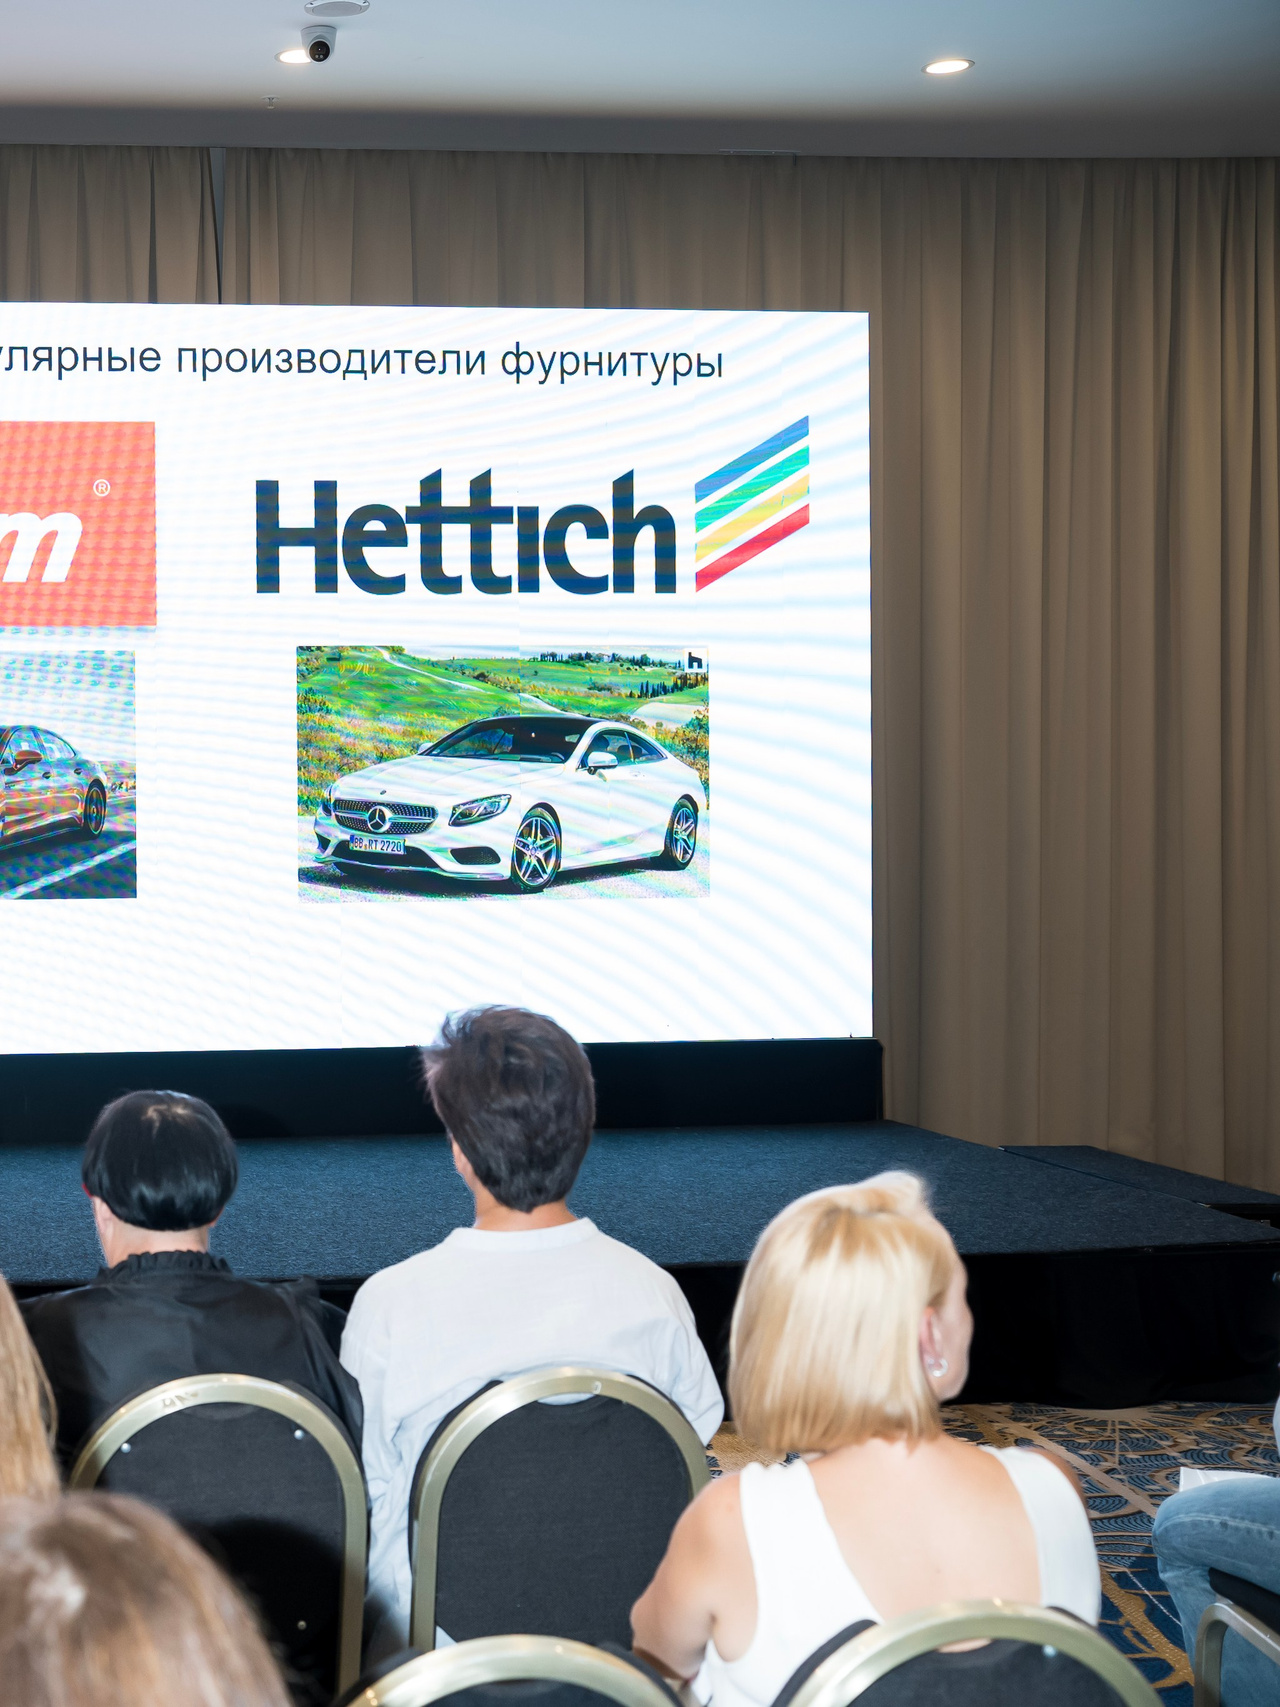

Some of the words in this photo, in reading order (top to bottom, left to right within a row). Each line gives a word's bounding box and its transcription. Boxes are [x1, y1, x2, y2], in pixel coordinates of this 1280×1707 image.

[176, 346, 487, 381] производители
[500, 341, 723, 386] фурнитуры
[255, 468, 677, 595] Hettich
